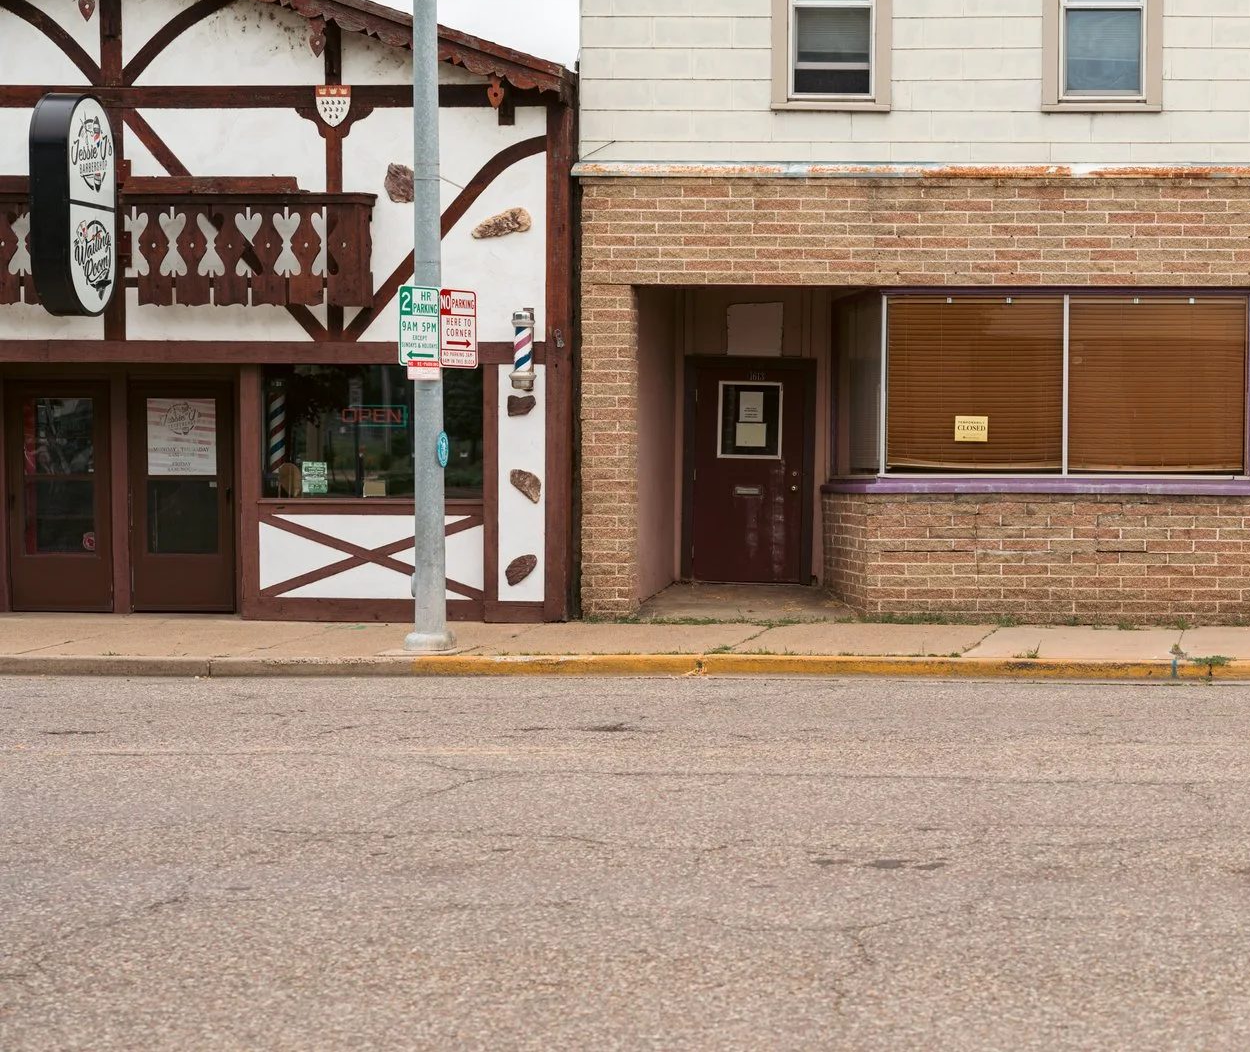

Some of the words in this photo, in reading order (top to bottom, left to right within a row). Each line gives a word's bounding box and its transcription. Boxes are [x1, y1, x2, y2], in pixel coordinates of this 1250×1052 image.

[71, 139, 98, 165] Jessie
[75, 226, 111, 266] Waiting
[83, 255, 110, 285] Room
[401, 291, 411, 312] 2
[420, 291, 432, 301] HR
[413, 303, 438, 315] PARKING
[440, 294, 451, 310] NO
[452, 299, 475, 310] PARKING
[402, 321, 418, 332] 9AM
[422, 322, 437, 333] 5PM
[446, 318, 461, 327] HERE
[464, 319, 472, 327] TO
[446, 328, 472, 338] CORNER
[341, 409, 401, 423] OPEN
